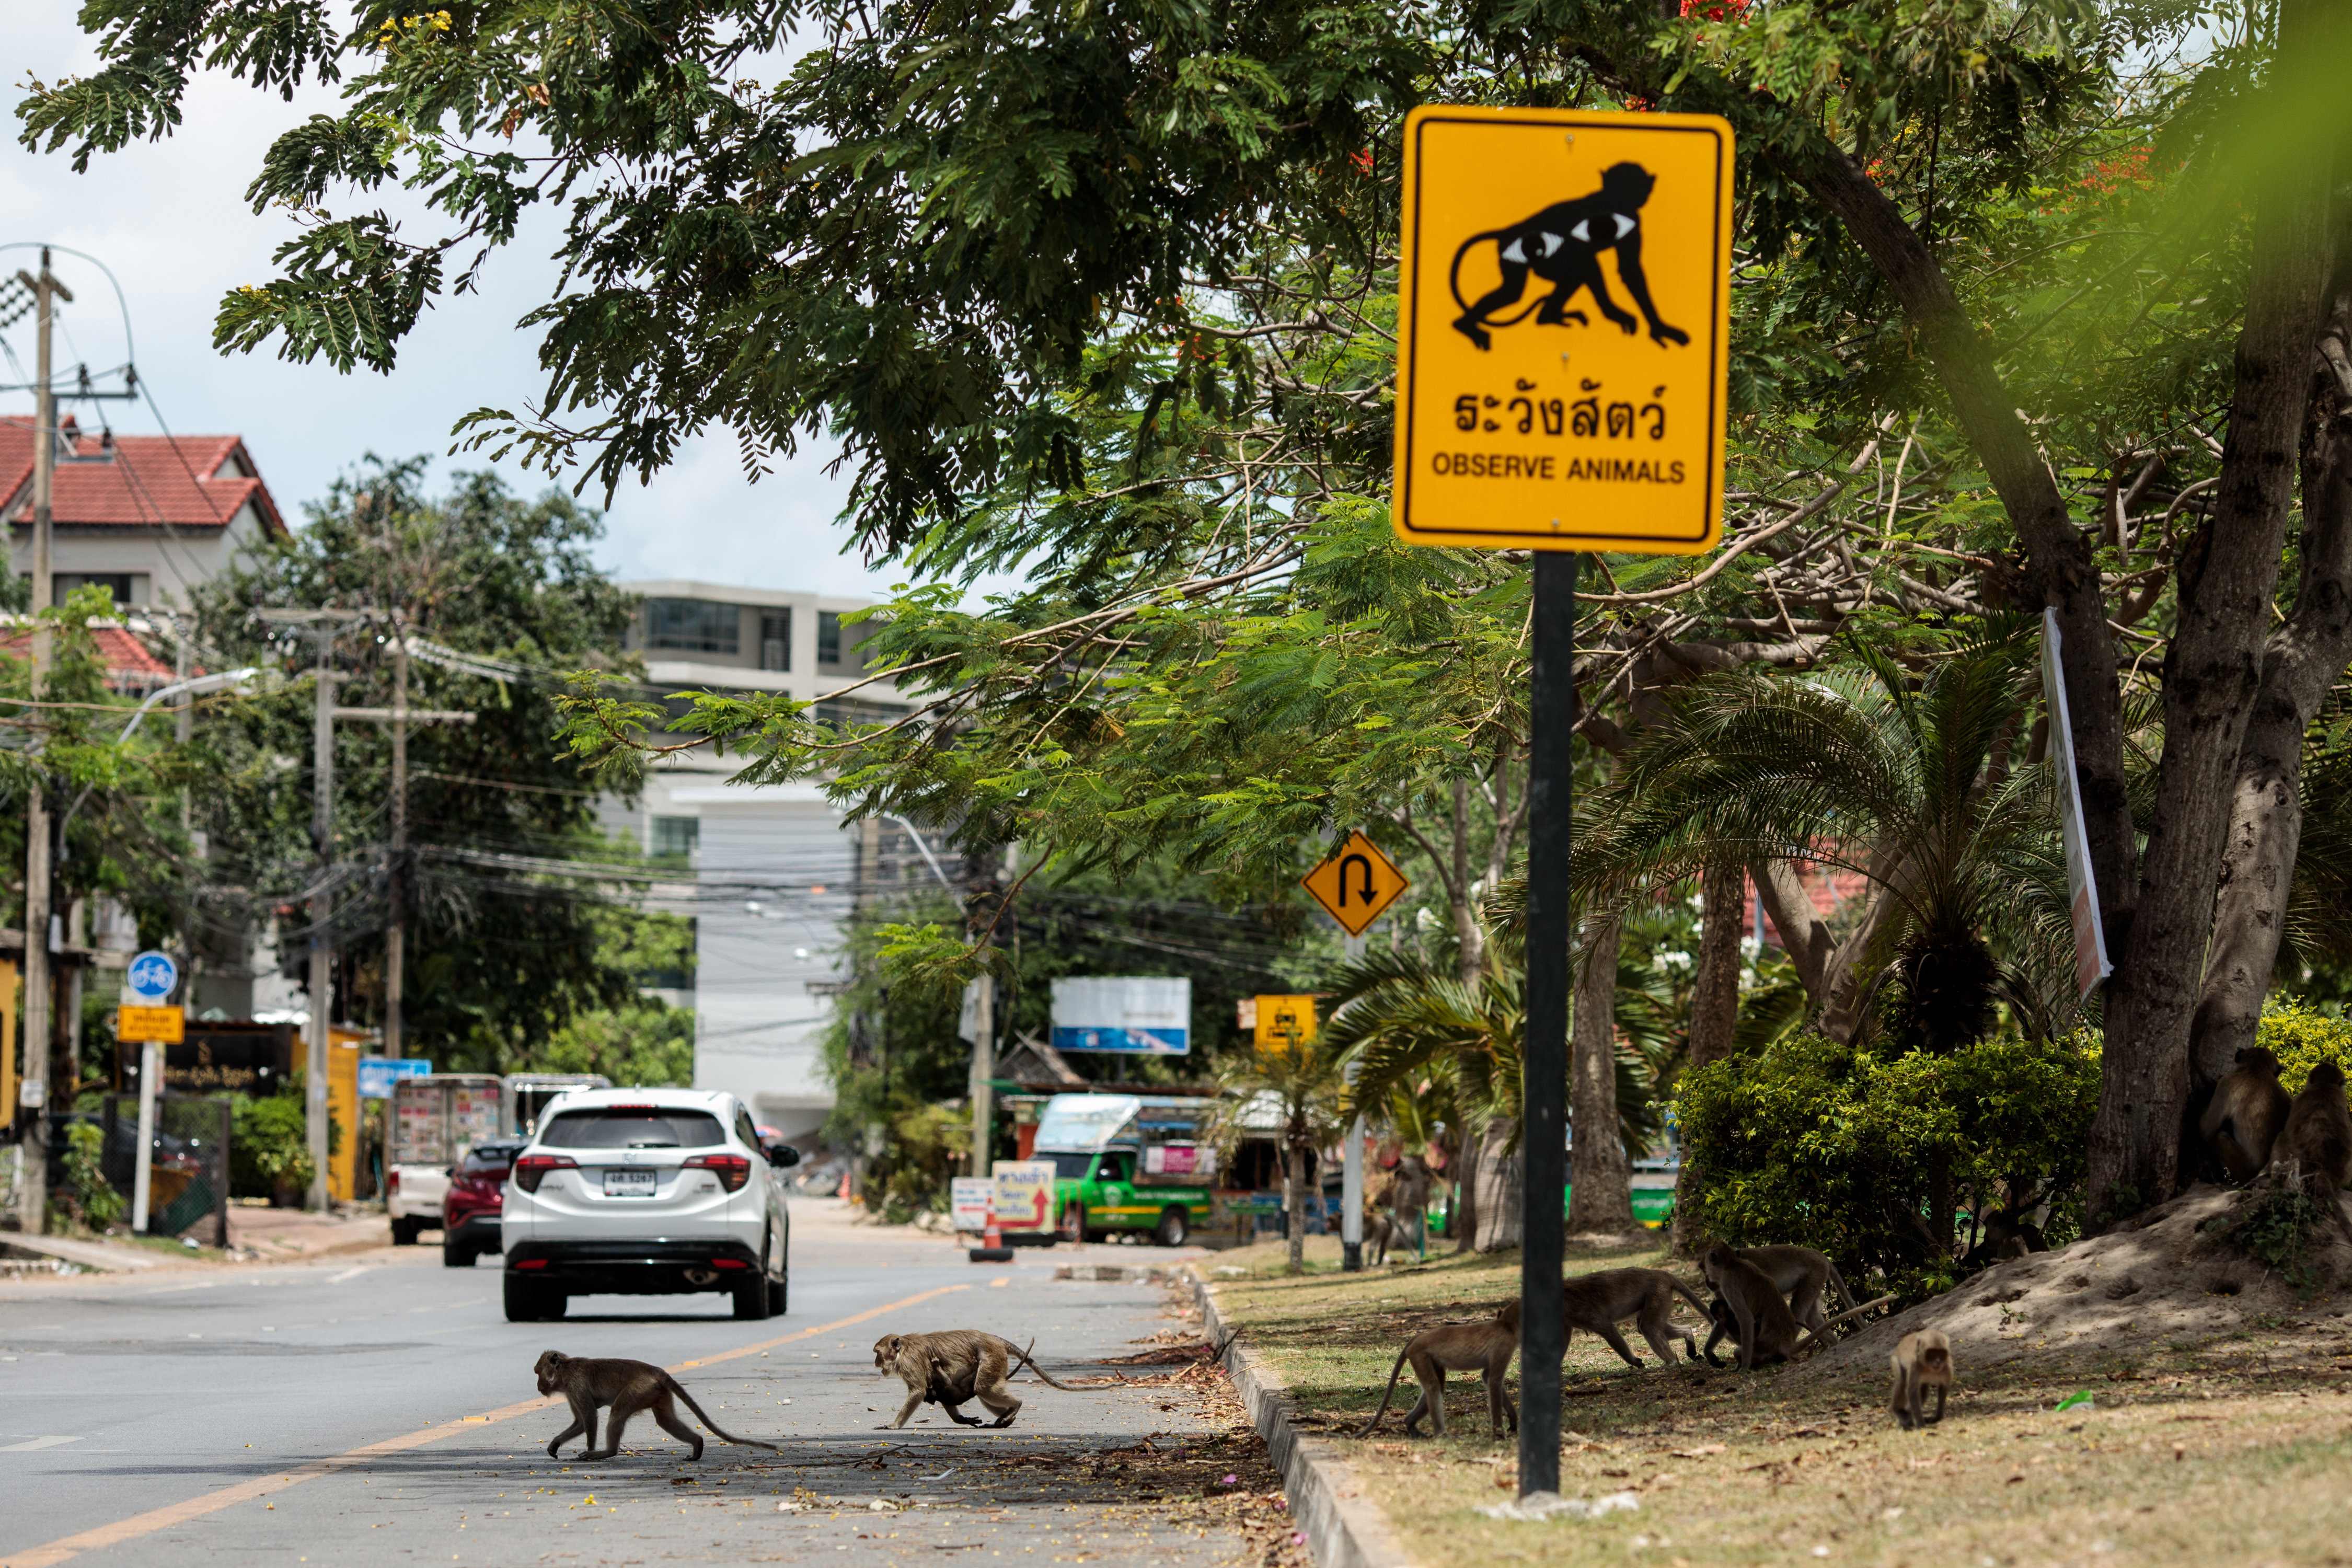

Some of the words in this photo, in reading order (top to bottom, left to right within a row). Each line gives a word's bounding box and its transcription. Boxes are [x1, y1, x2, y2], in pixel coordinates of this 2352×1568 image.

[1455, 377, 1666, 441] ระวังสัตว์
[1432, 452, 1555, 479] OBSERVE
[1566, 457, 1685, 485] ANIMALS
